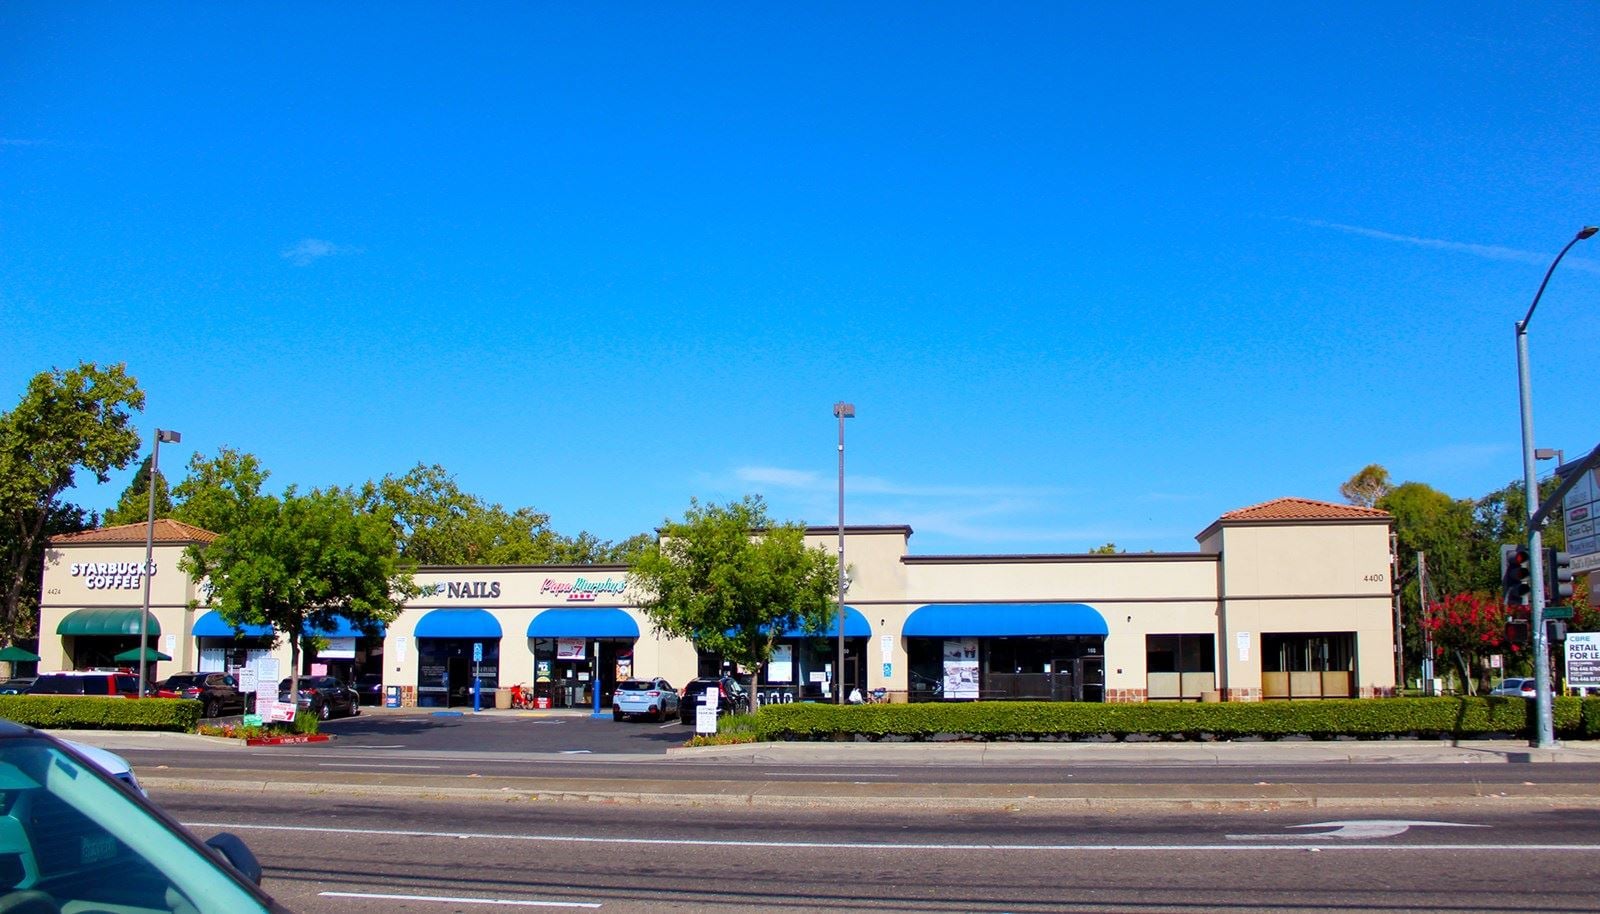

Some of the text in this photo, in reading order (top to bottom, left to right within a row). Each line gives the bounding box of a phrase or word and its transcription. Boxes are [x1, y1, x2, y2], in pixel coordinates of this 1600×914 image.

[71, 562, 157, 577] STARBUCKS
[85, 575, 141, 590] COFFEE
[1363, 574, 1384, 582] 4400
[47, 588, 62, 596] 4424
[447, 581, 501, 598] NAILS
[541, 579, 573, 597] Papa
[1569, 644, 1598, 652] RETAIL
[1569, 652, 1600, 660] FOR LE
